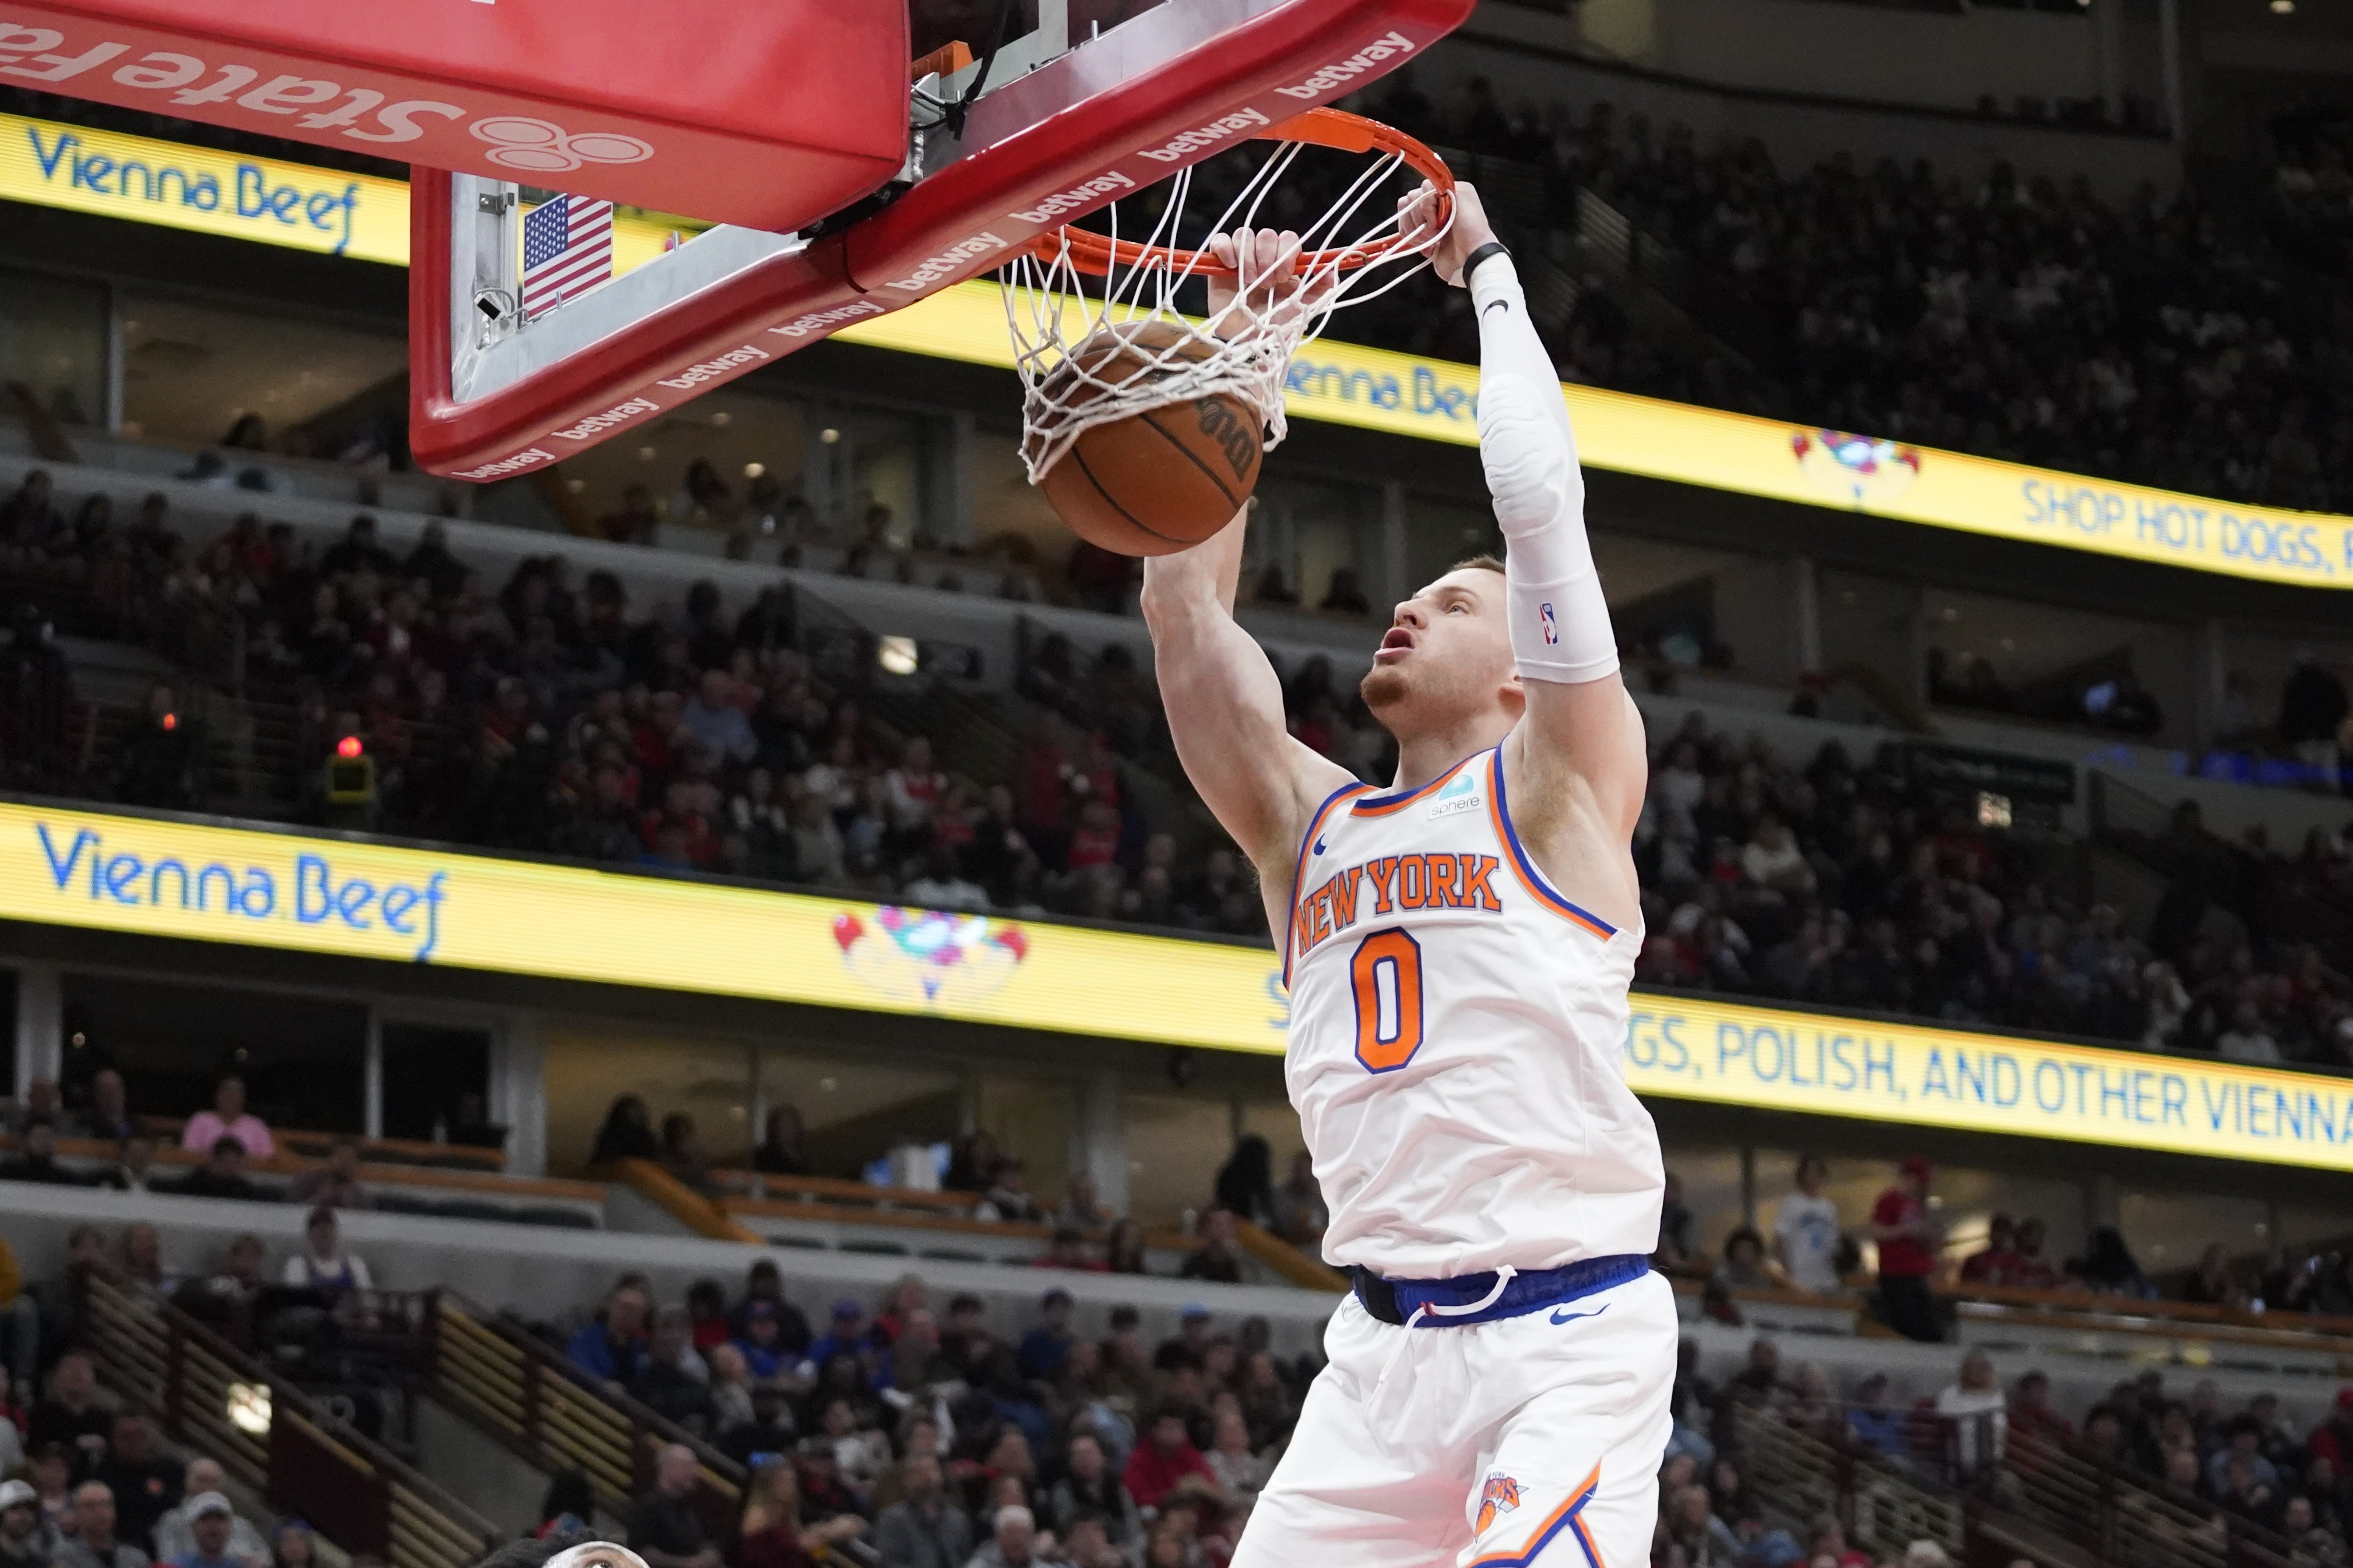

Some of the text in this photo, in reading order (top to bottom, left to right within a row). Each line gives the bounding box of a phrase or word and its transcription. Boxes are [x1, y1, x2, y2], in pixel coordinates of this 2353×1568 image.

[1275, 31, 1415, 99] betway
[1138, 107, 1270, 163] betway
[27, 127, 359, 256] Vienna Beef
[1009, 171, 1135, 224] betway
[885, 232, 1008, 293] betway
[768, 299, 885, 337] betway
[657, 343, 769, 390] betway
[1285, 360, 1400, 410] enna
[551, 396, 660, 441] betway
[452, 446, 555, 480] betway
[2023, 478, 2125, 533] SHOP
[2136, 500, 2208, 550] HOT
[2221, 513, 2334, 574] DOGS,
[1431, 795, 1480, 816] sphere
[36, 822, 449, 963] Vienna Beef
[1297, 853, 1503, 959] NEW YORK
[1350, 926, 1424, 1074] 0
[1627, 1013, 1703, 1080] GS,
[1716, 1022, 1907, 1101] POLISH,
[1922, 1046, 2023, 1108] AND
[2033, 1060, 2189, 1127] OTHER
